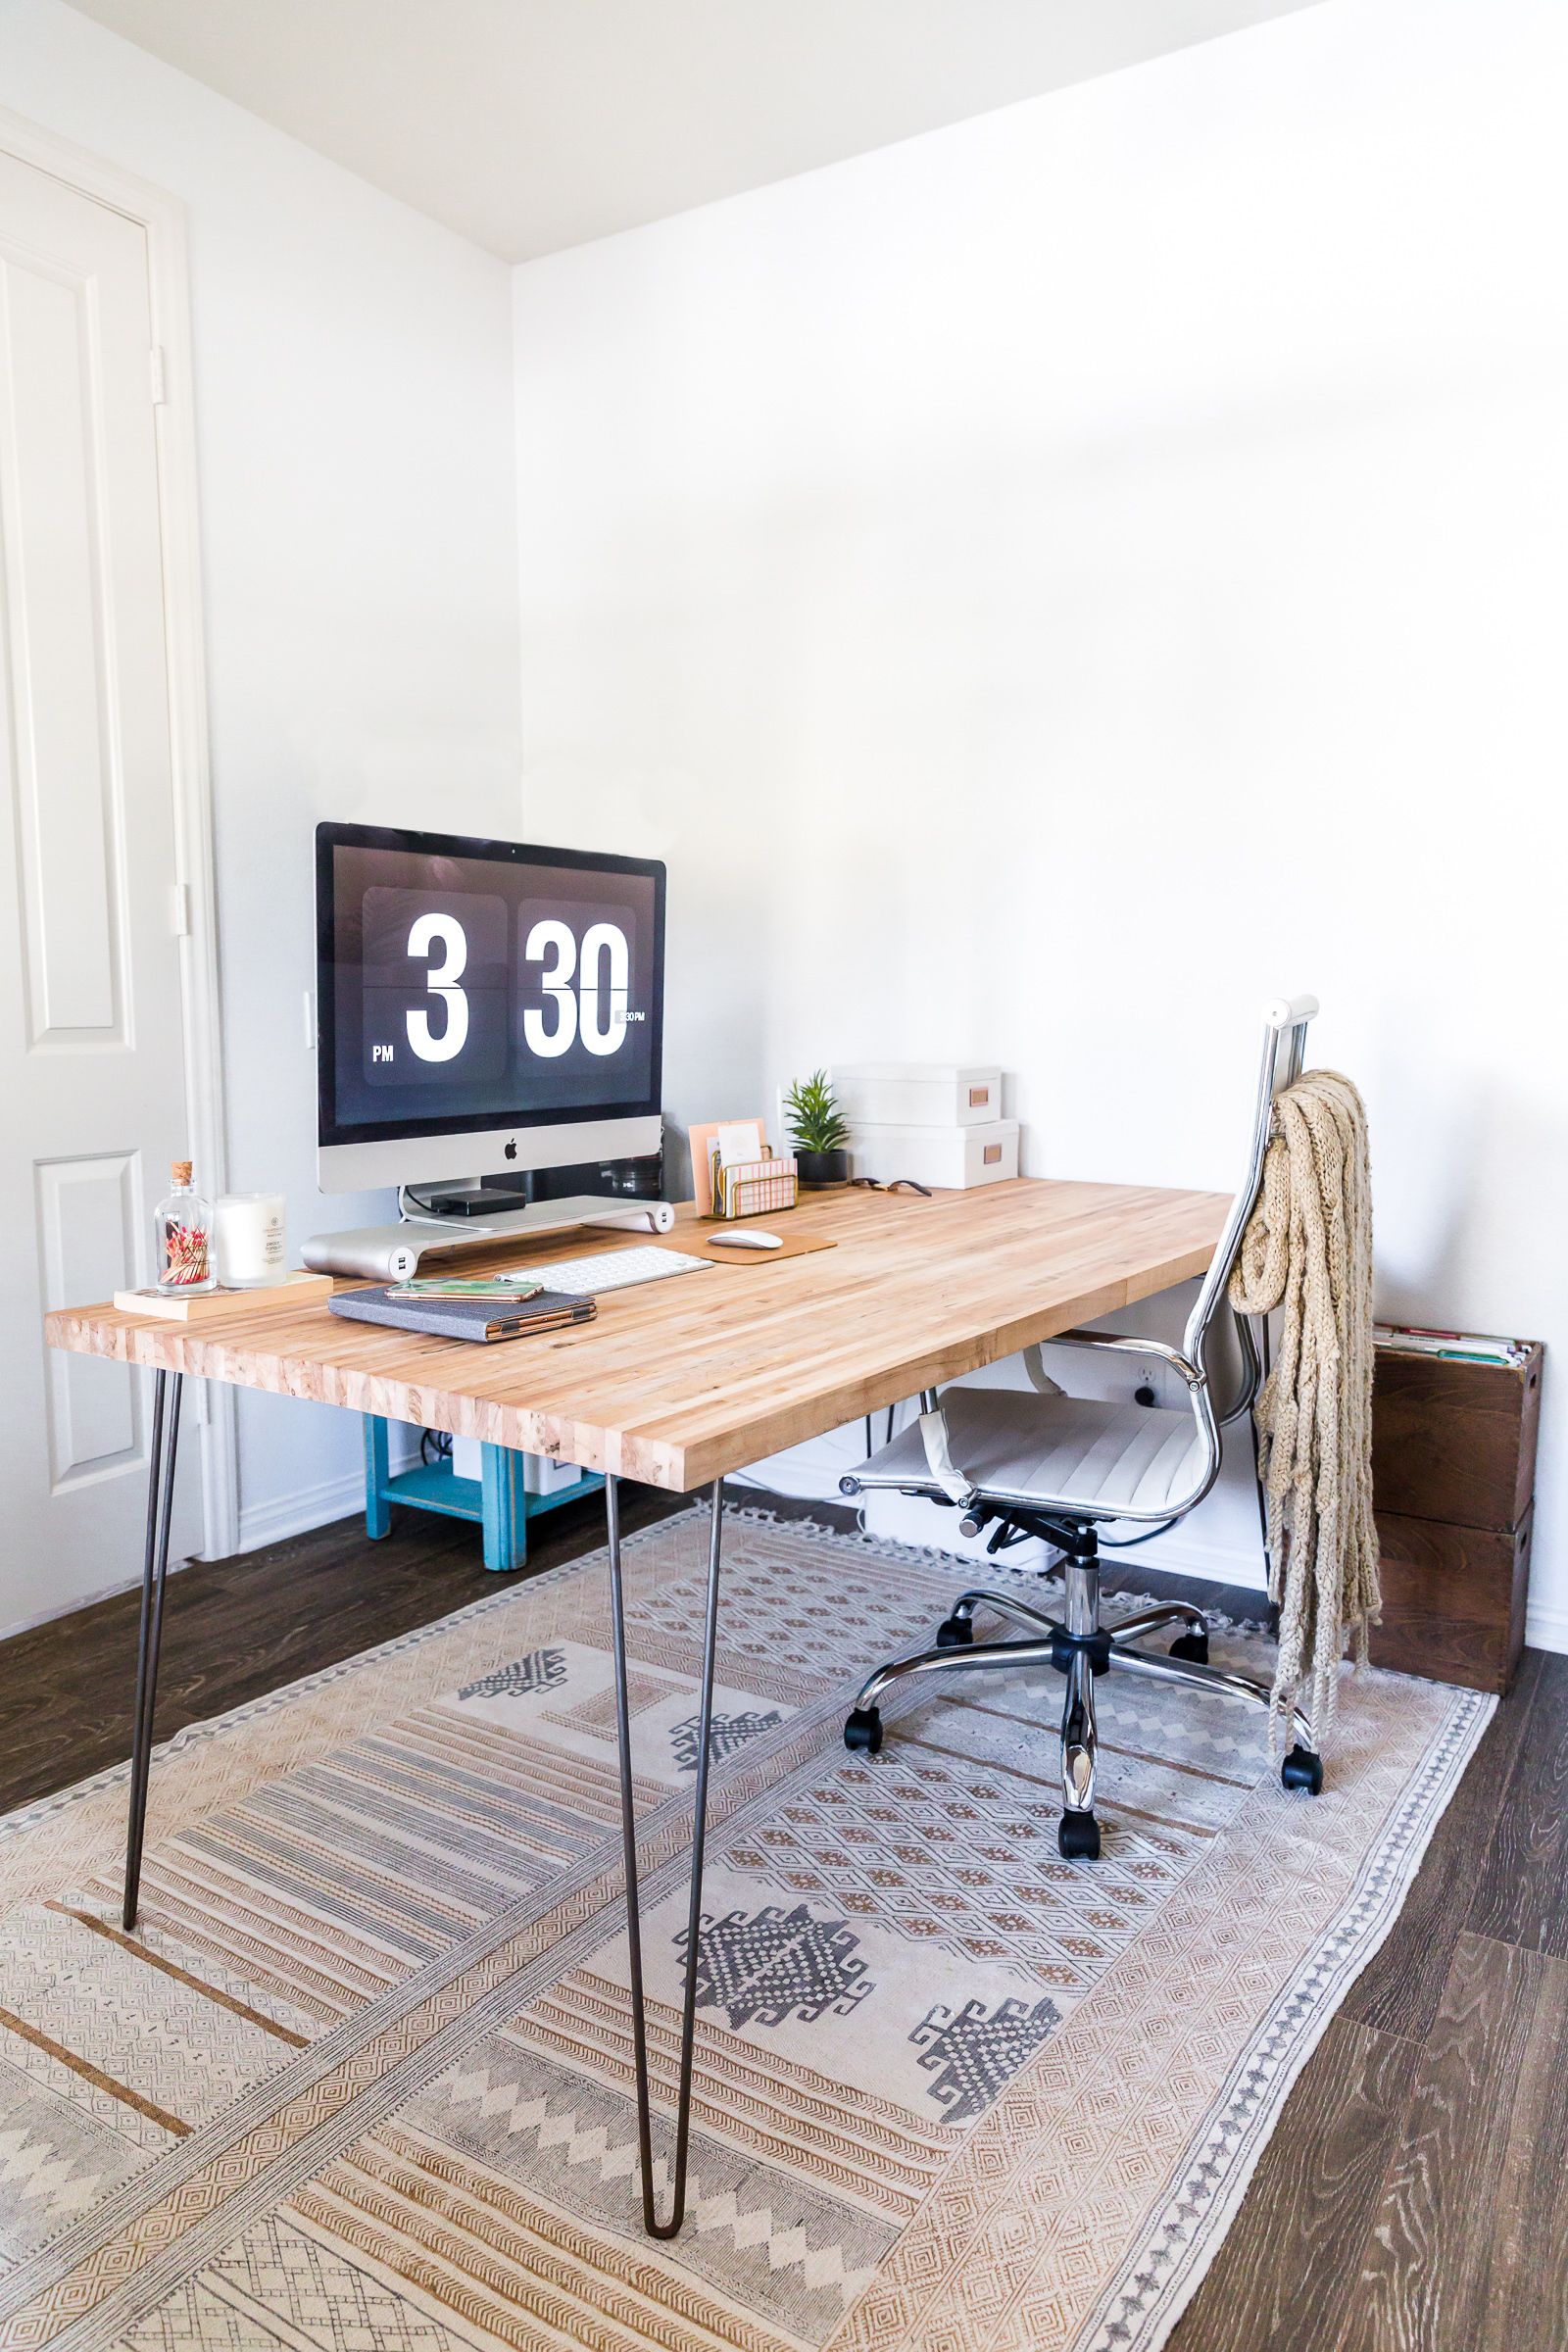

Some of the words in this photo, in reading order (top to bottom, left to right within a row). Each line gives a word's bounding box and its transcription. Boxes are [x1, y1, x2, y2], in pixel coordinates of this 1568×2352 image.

[406, 912, 469, 1062] 3
[523, 919, 629, 1058] 30
[634, 1011, 646, 1021] PM
[372, 1045, 394, 1062] PM
